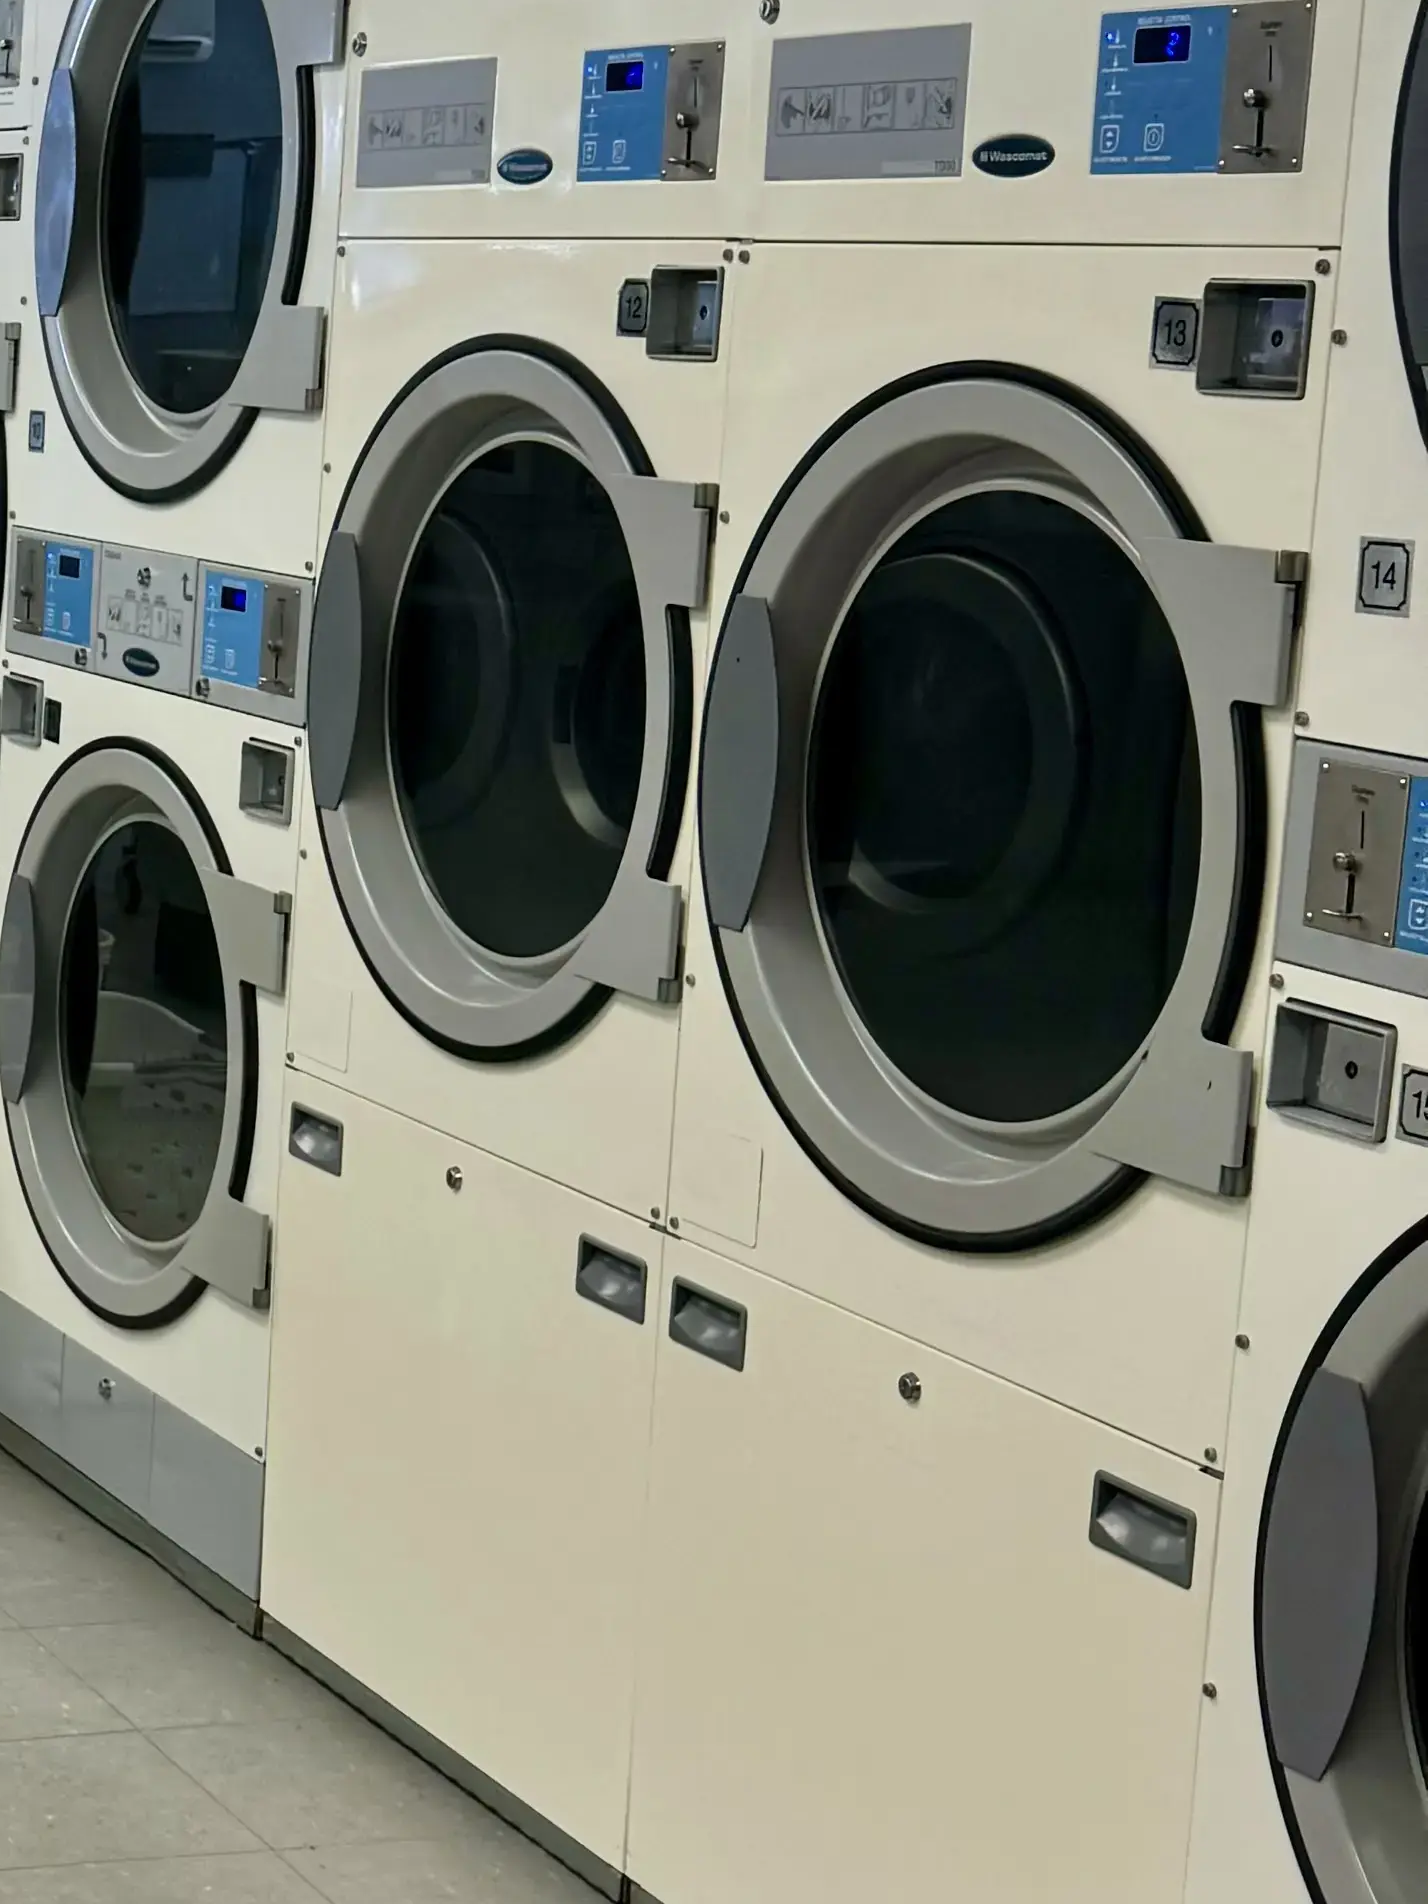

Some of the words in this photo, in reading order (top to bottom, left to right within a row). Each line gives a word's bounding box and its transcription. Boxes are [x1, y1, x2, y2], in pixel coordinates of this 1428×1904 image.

[989, 150, 1048, 162] Wascomat
[625, 295, 642, 319] 12
[1164, 319, 1187, 347] 13
[1371, 560, 1396, 591] 14
